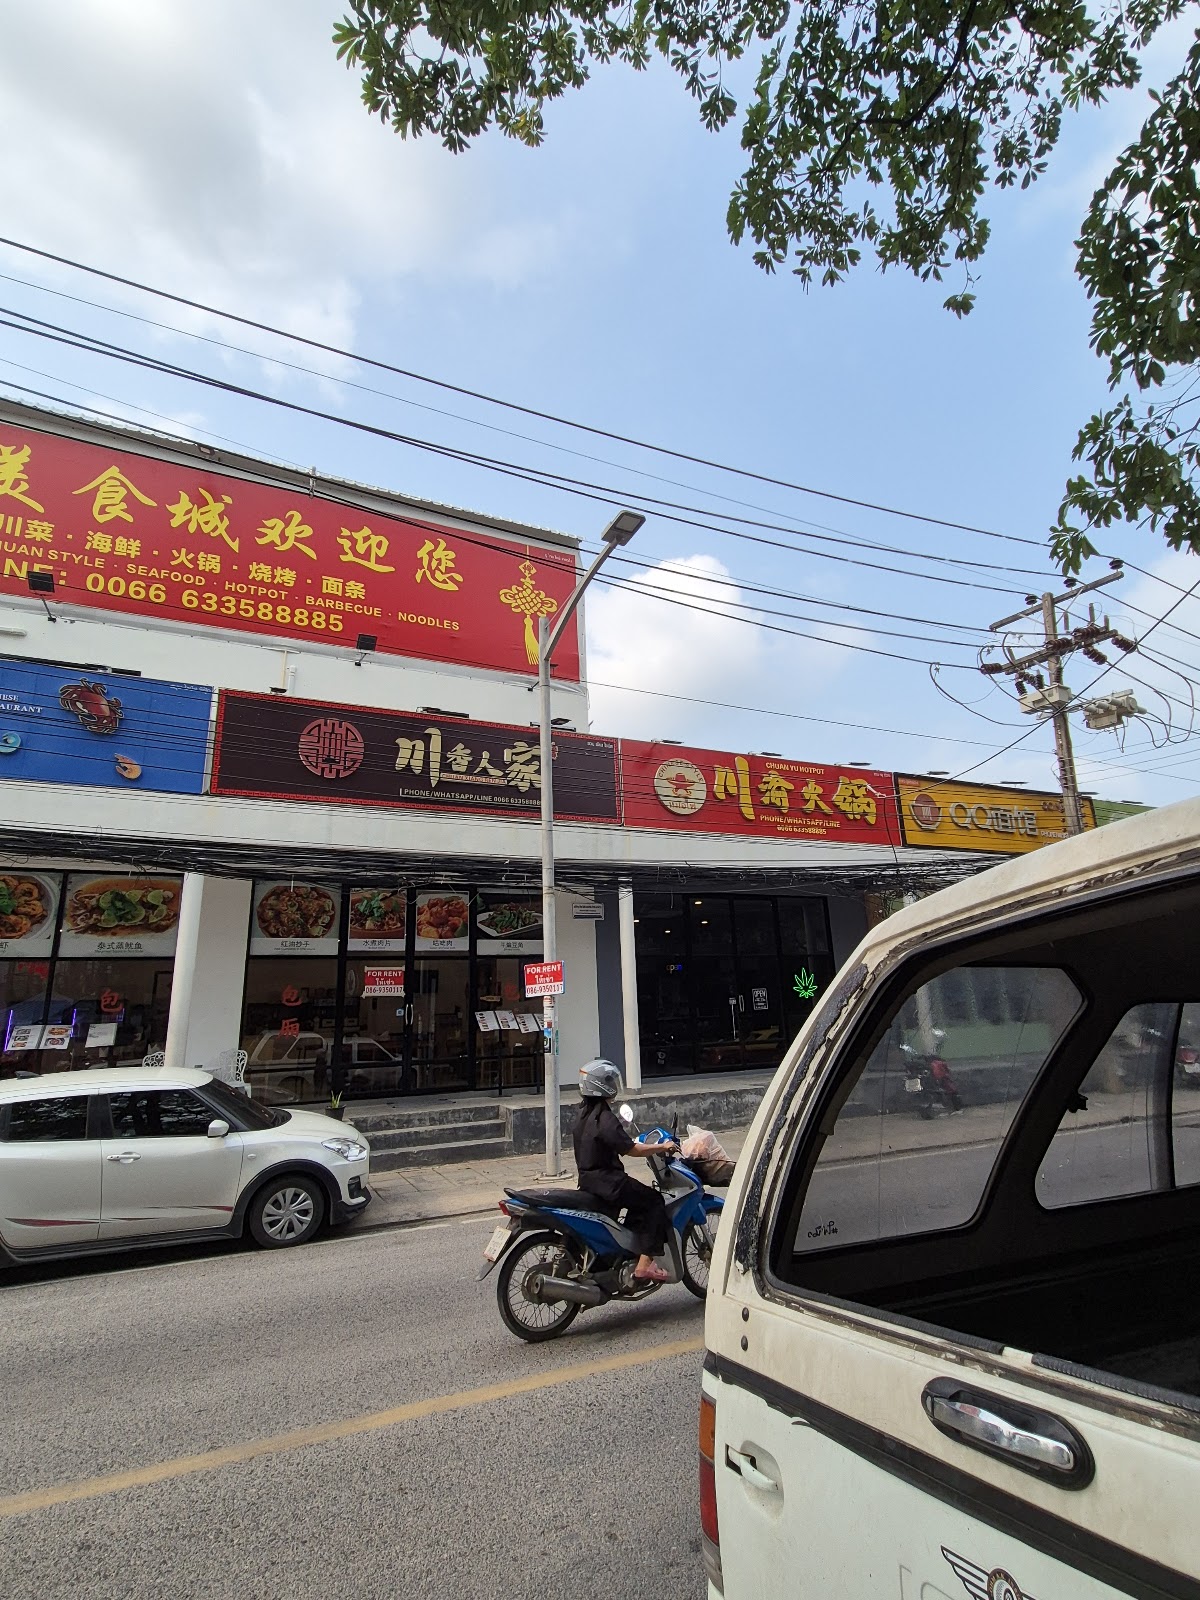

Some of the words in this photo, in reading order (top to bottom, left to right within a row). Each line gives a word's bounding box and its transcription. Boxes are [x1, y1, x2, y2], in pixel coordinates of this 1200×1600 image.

[85, 530, 141, 559] 海鲜
[170, 548, 221, 574] 火锅
[249, 561, 297, 587] 烧烤
[321, 575, 366, 600] 面条
[47, 549, 105, 569] STYLE
[126, 563, 206, 586] SEAFOOD
[224, 581, 288, 600] HOTPOT
[305, 595, 382, 618] BARBECUE
[398, 611, 460, 632] NOODLES
[85, 573, 167, 604] 0066
[181, 589, 344, 632] 633588885
[766, 762, 789, 770] CHUAN
[790, 764, 799, 772] YU
[800, 766, 825, 774] HOTPOT
[404, 788, 492, 801] PHONE/WHATSAPP/LINE
[760, 815, 840, 827] PHONE/WHATSAPP/LINE
[527, 966, 540, 974] FOR
[542, 964, 561, 973] RENT
